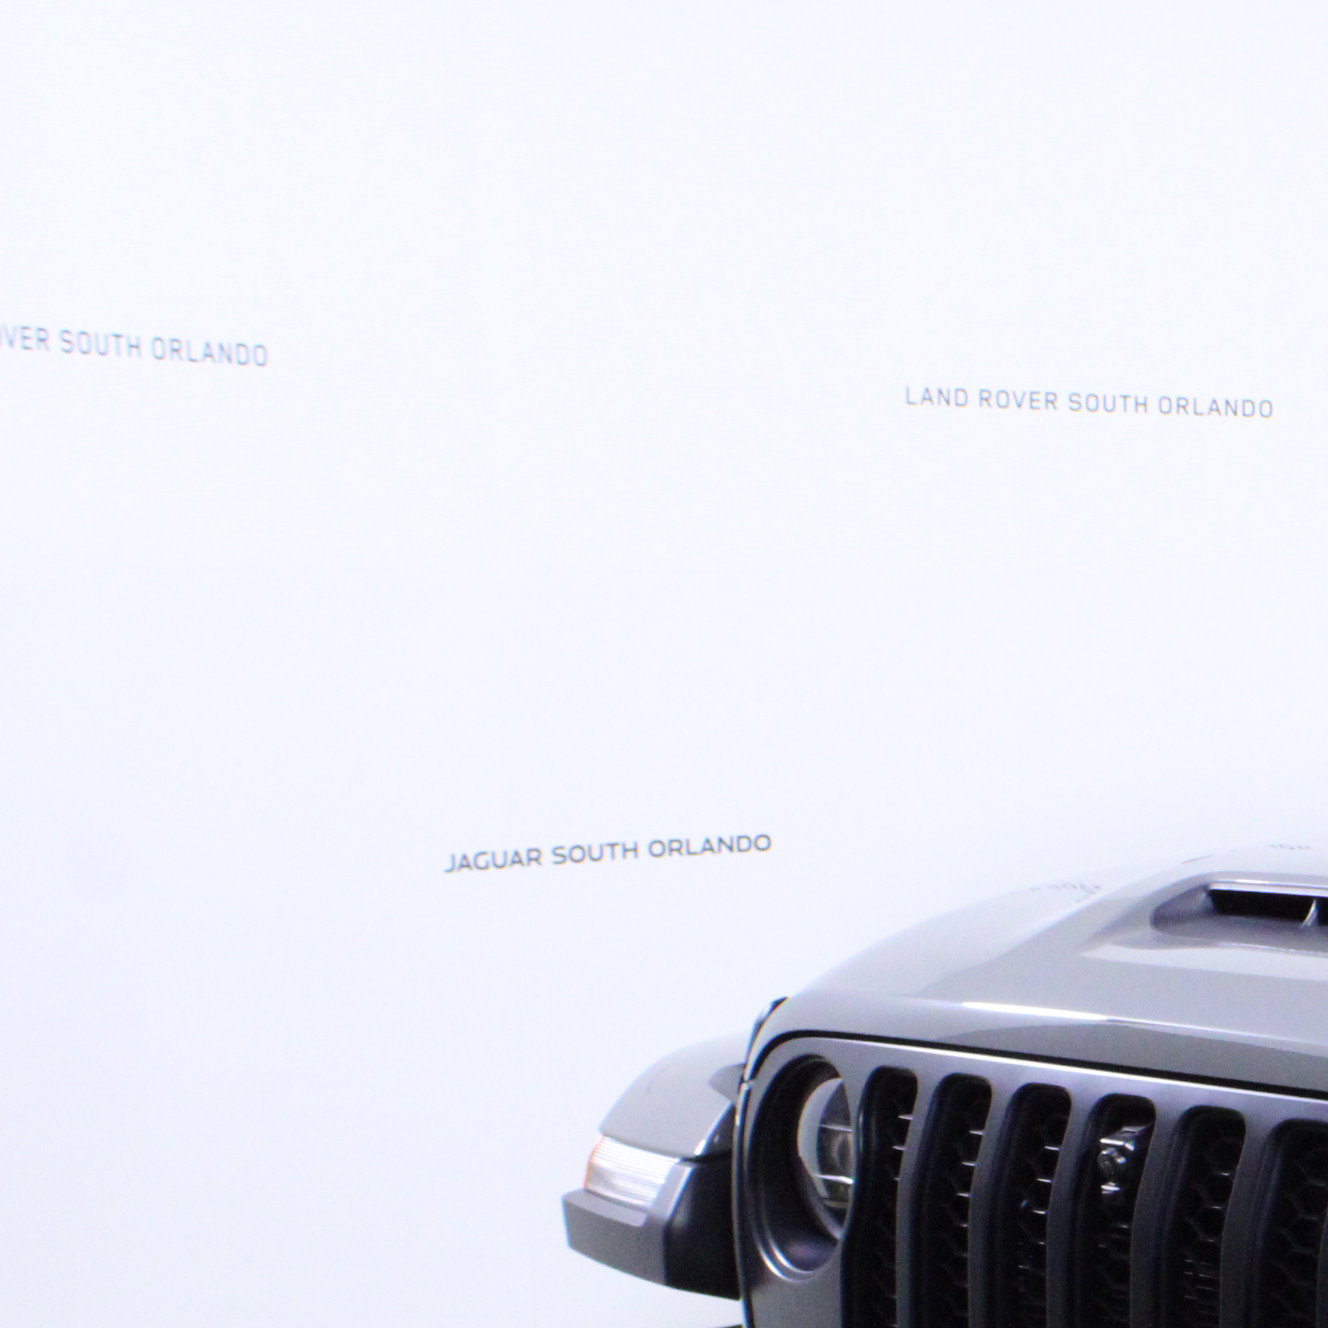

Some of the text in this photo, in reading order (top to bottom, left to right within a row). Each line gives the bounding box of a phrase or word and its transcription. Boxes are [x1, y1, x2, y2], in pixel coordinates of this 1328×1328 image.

[0, 323, 268, 368] VER SOUTH ORLANDO
[905, 386, 1274, 419] LAND ROVER SOUTH ORLANDO
[443, 832, 773, 874] JAGUAR SOUTH ORLANDO
